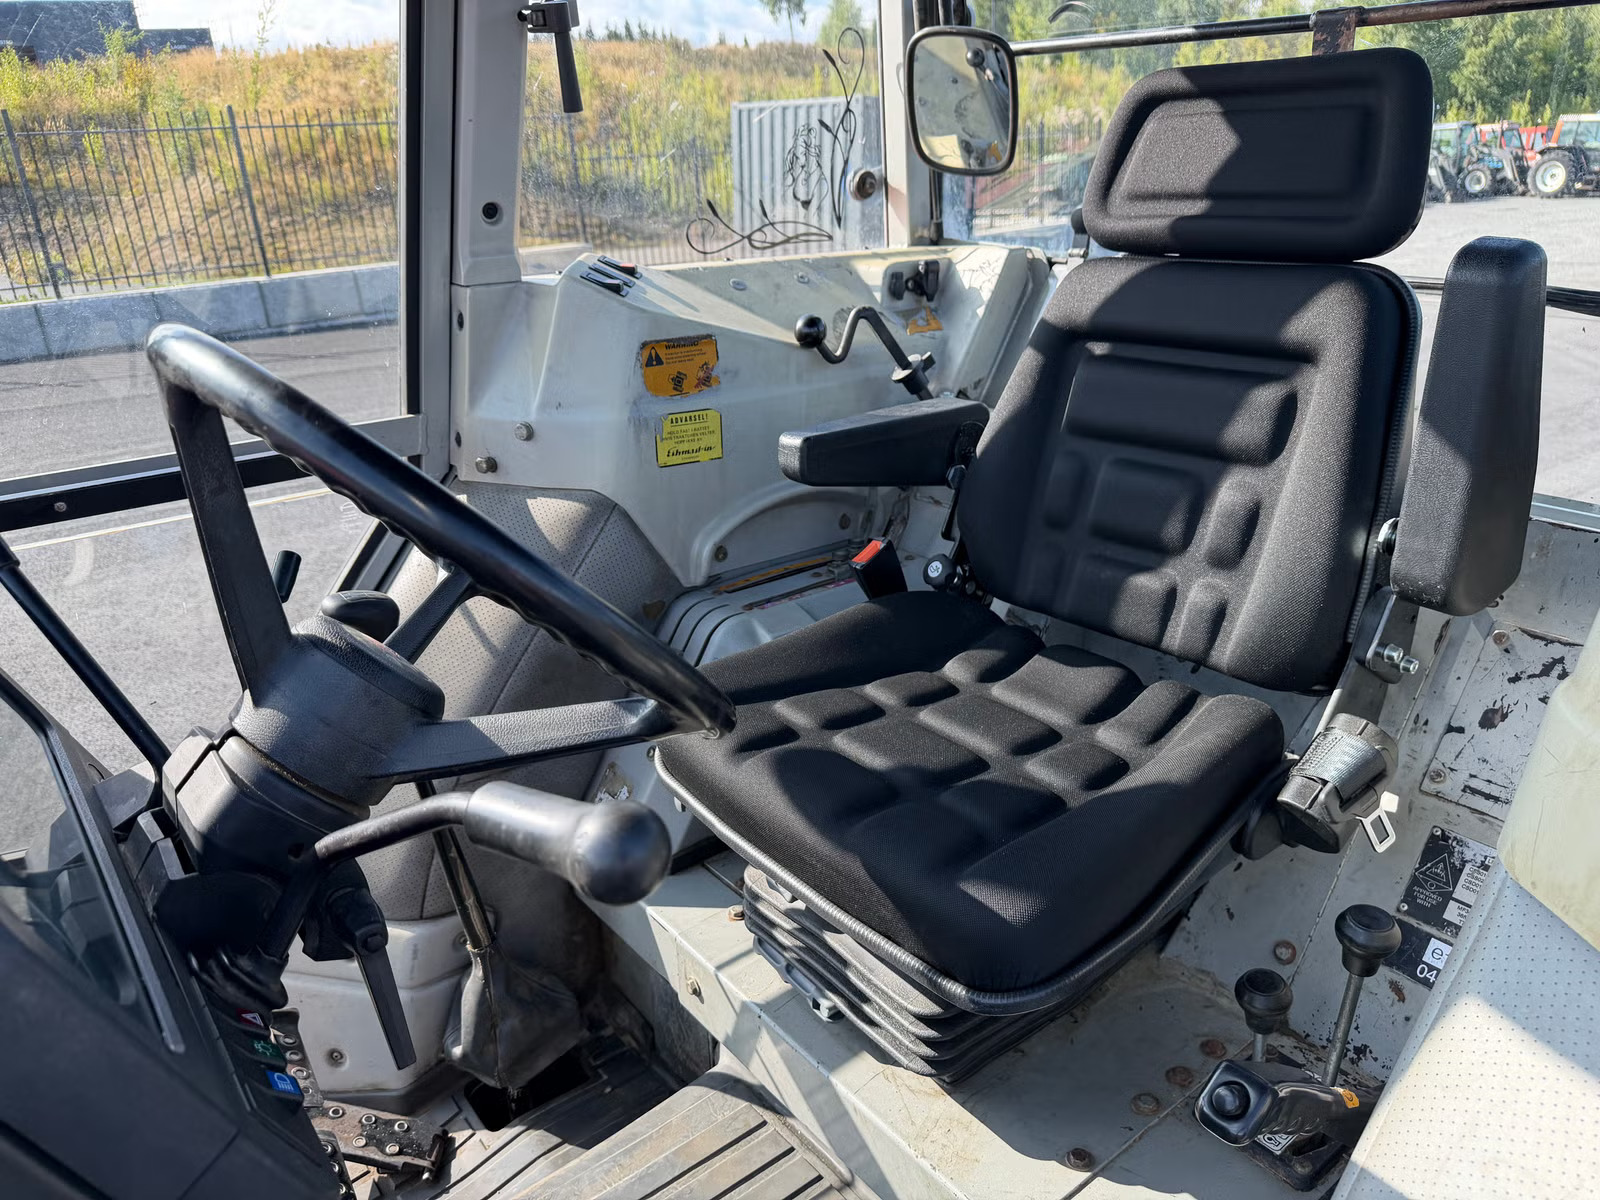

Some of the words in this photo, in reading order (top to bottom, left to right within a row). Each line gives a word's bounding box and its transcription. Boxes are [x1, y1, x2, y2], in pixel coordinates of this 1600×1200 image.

[670, 413, 708, 424] ADVARSEL!
[1413, 886, 1442, 902] APPROVED
[1416, 898, 1431, 908] WITH
[1416, 964, 1438, 982] 04
